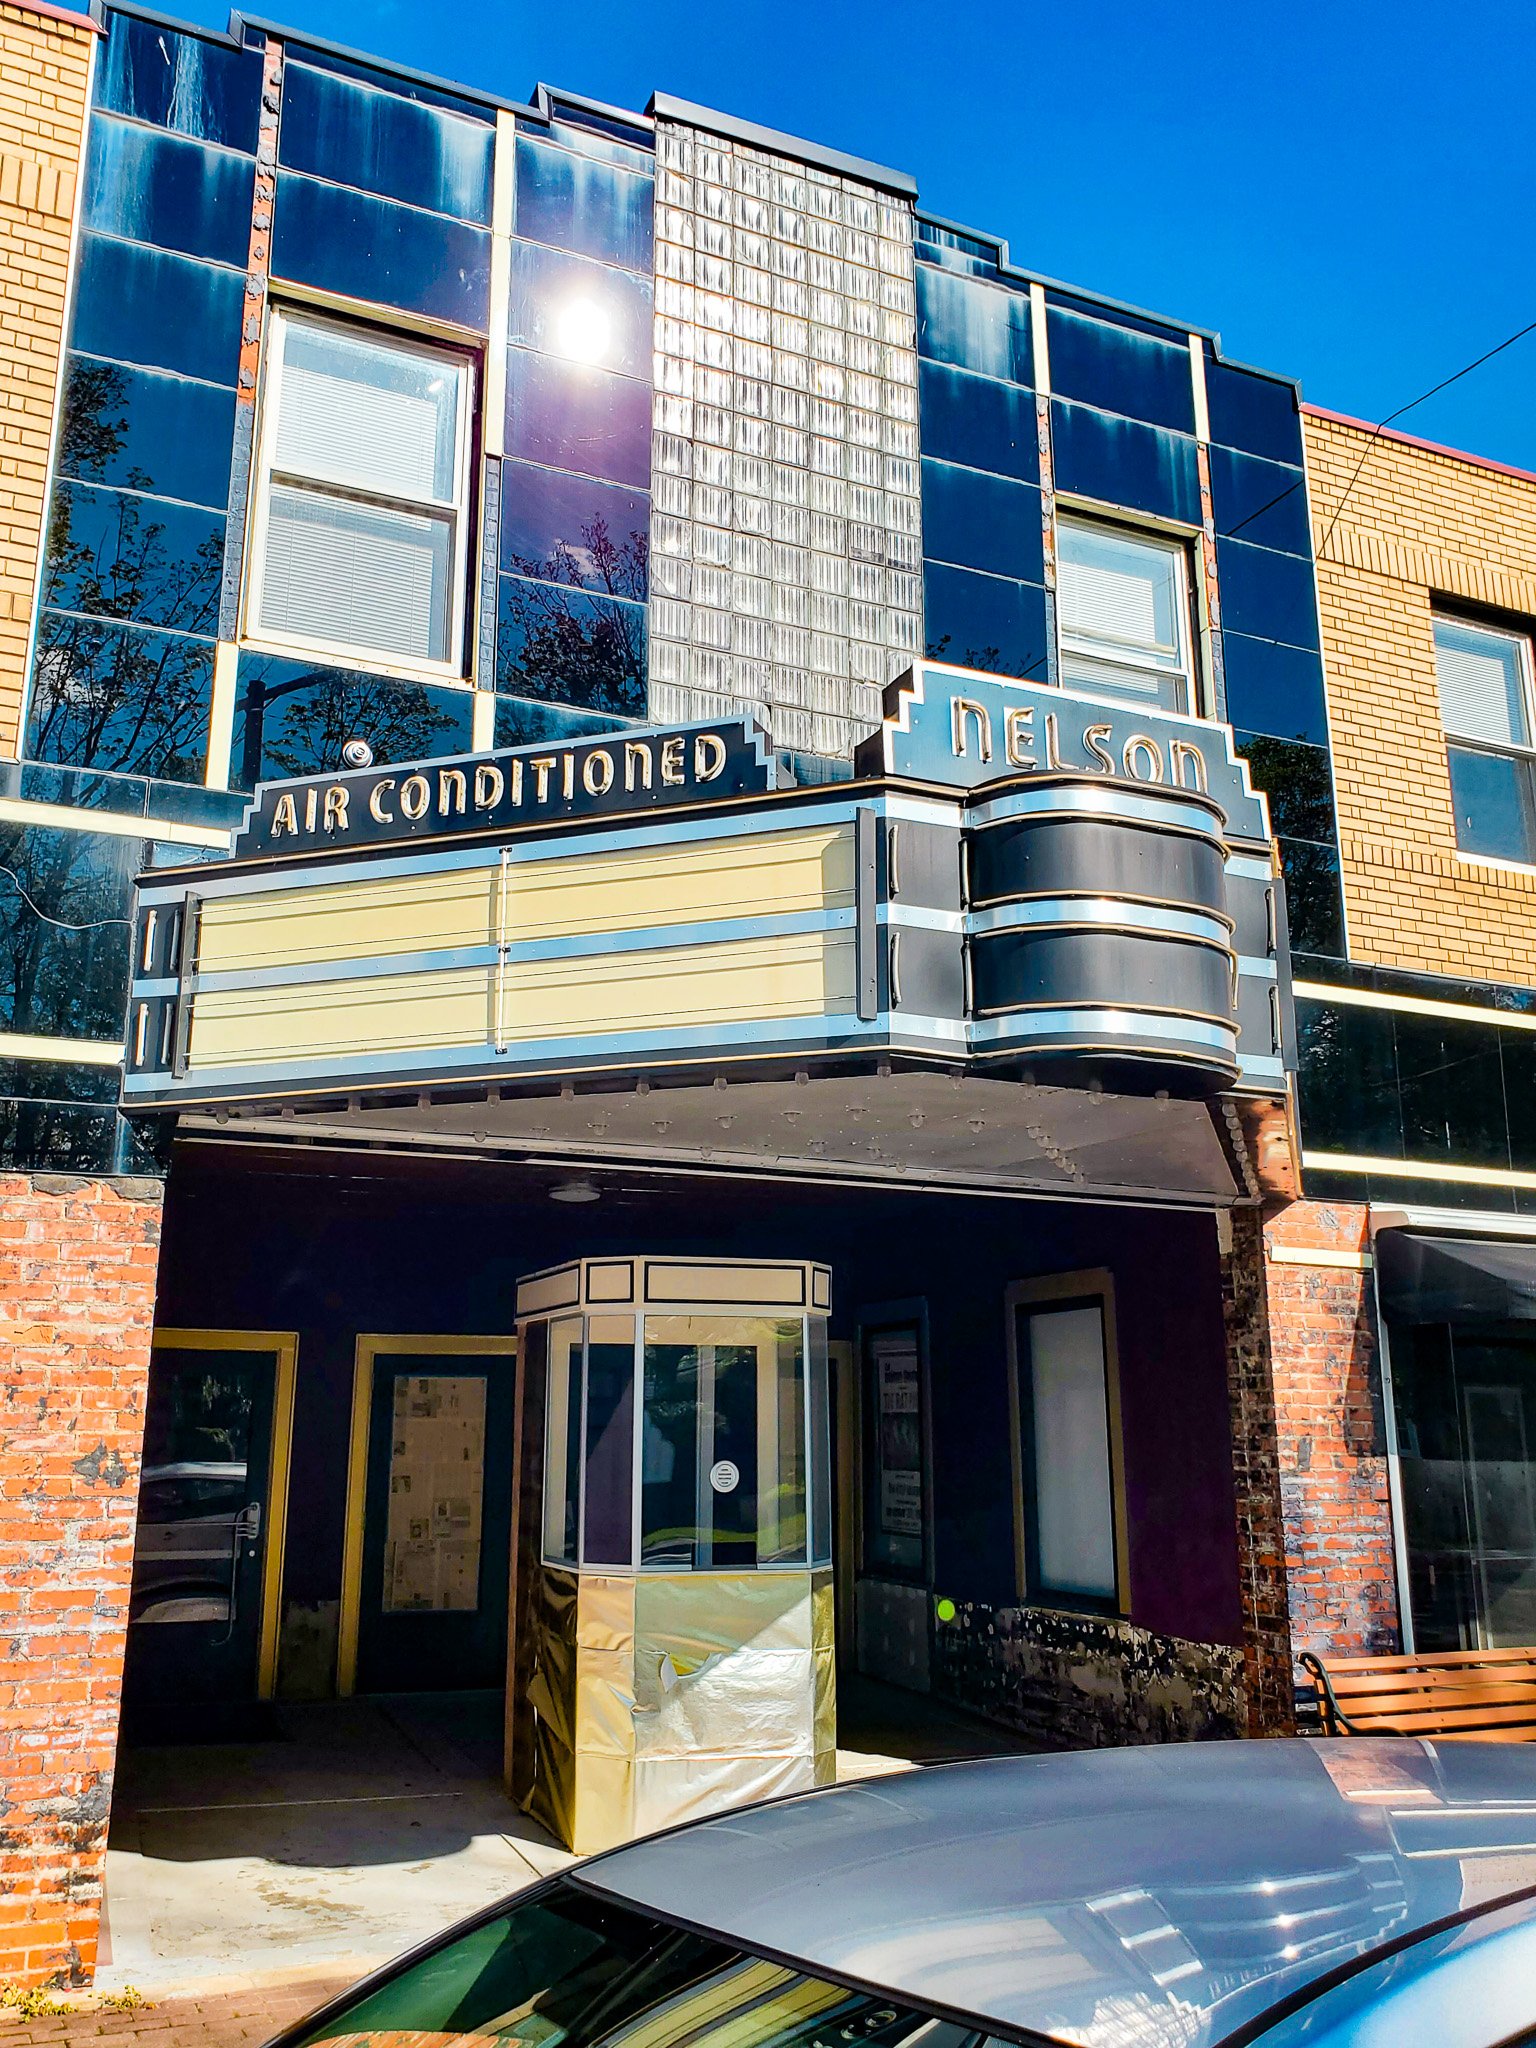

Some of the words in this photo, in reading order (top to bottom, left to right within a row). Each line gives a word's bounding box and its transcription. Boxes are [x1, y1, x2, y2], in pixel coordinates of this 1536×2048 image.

[269, 786, 350, 838] AIR
[370, 735, 727, 824] CONDITIONED
[950, 697, 1208, 795] NELSON
